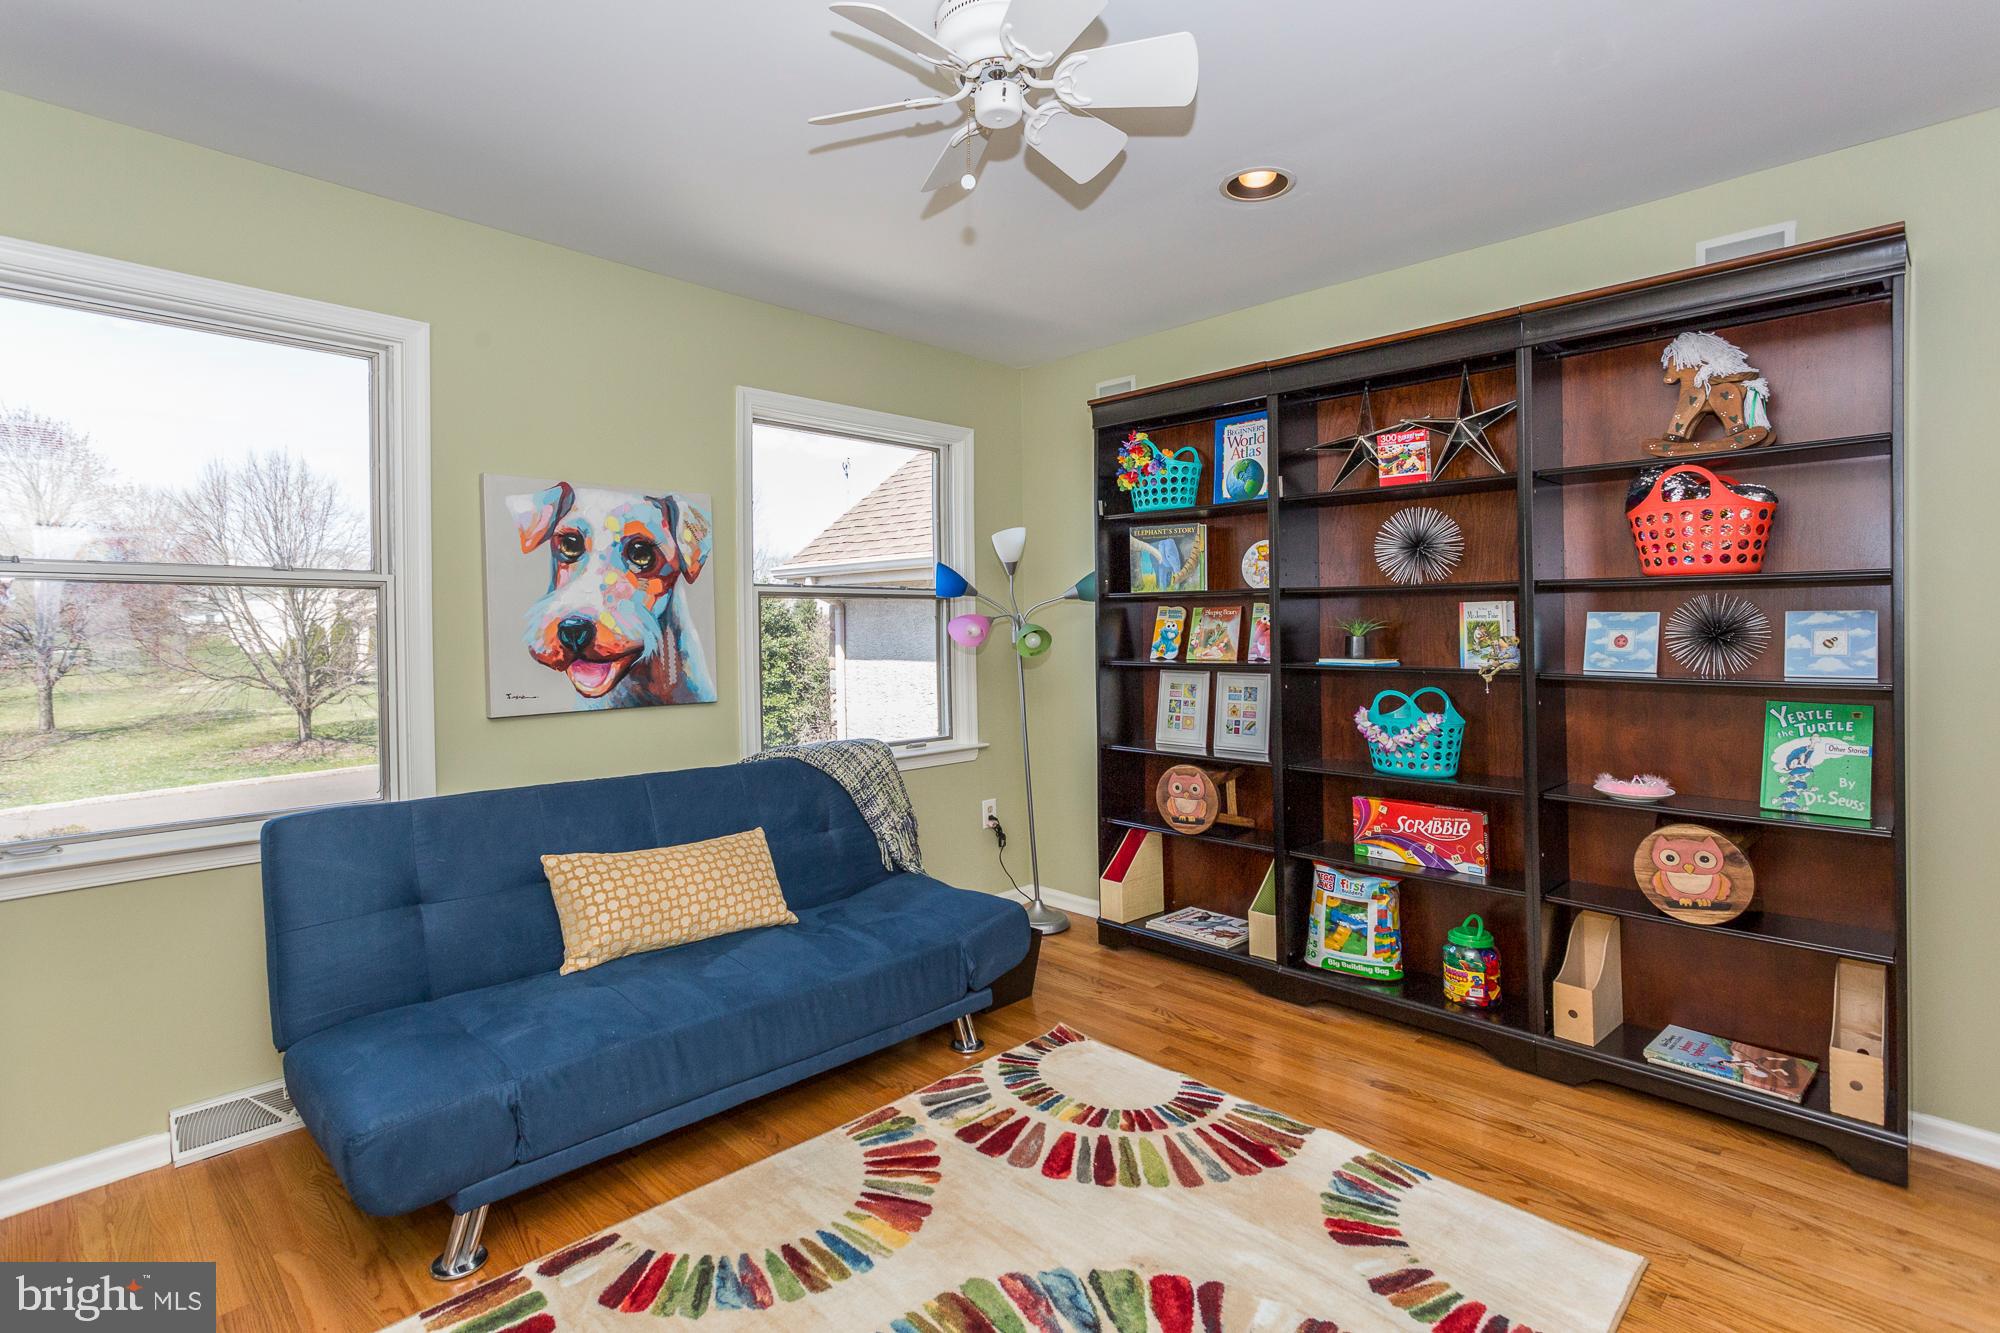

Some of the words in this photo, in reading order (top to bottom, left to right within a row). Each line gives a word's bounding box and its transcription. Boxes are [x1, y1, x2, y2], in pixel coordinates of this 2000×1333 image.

[1227, 432, 1265, 448] World
[1380, 433, 1397, 443] 300
[1230, 446, 1262, 460] Atlas
[1134, 528, 1173, 536] ELEPHANT'S
[1770, 705, 1833, 728] YERTLE
[1777, 729, 1794, 738] the
[1794, 721, 1854, 737] TURTLE
[1828, 744, 1846, 753] Other
[1847, 746, 1868, 755] Stories
[1839, 777, 1856, 790] By
[1802, 790, 1826, 806] Dr.
[1828, 790, 1866, 811] Seuss
[1340, 878, 1366, 893] first
[1328, 958, 1340, 968] Big
[1341, 961, 1373, 974] Building
[1374, 966, 1390, 976] Bag
